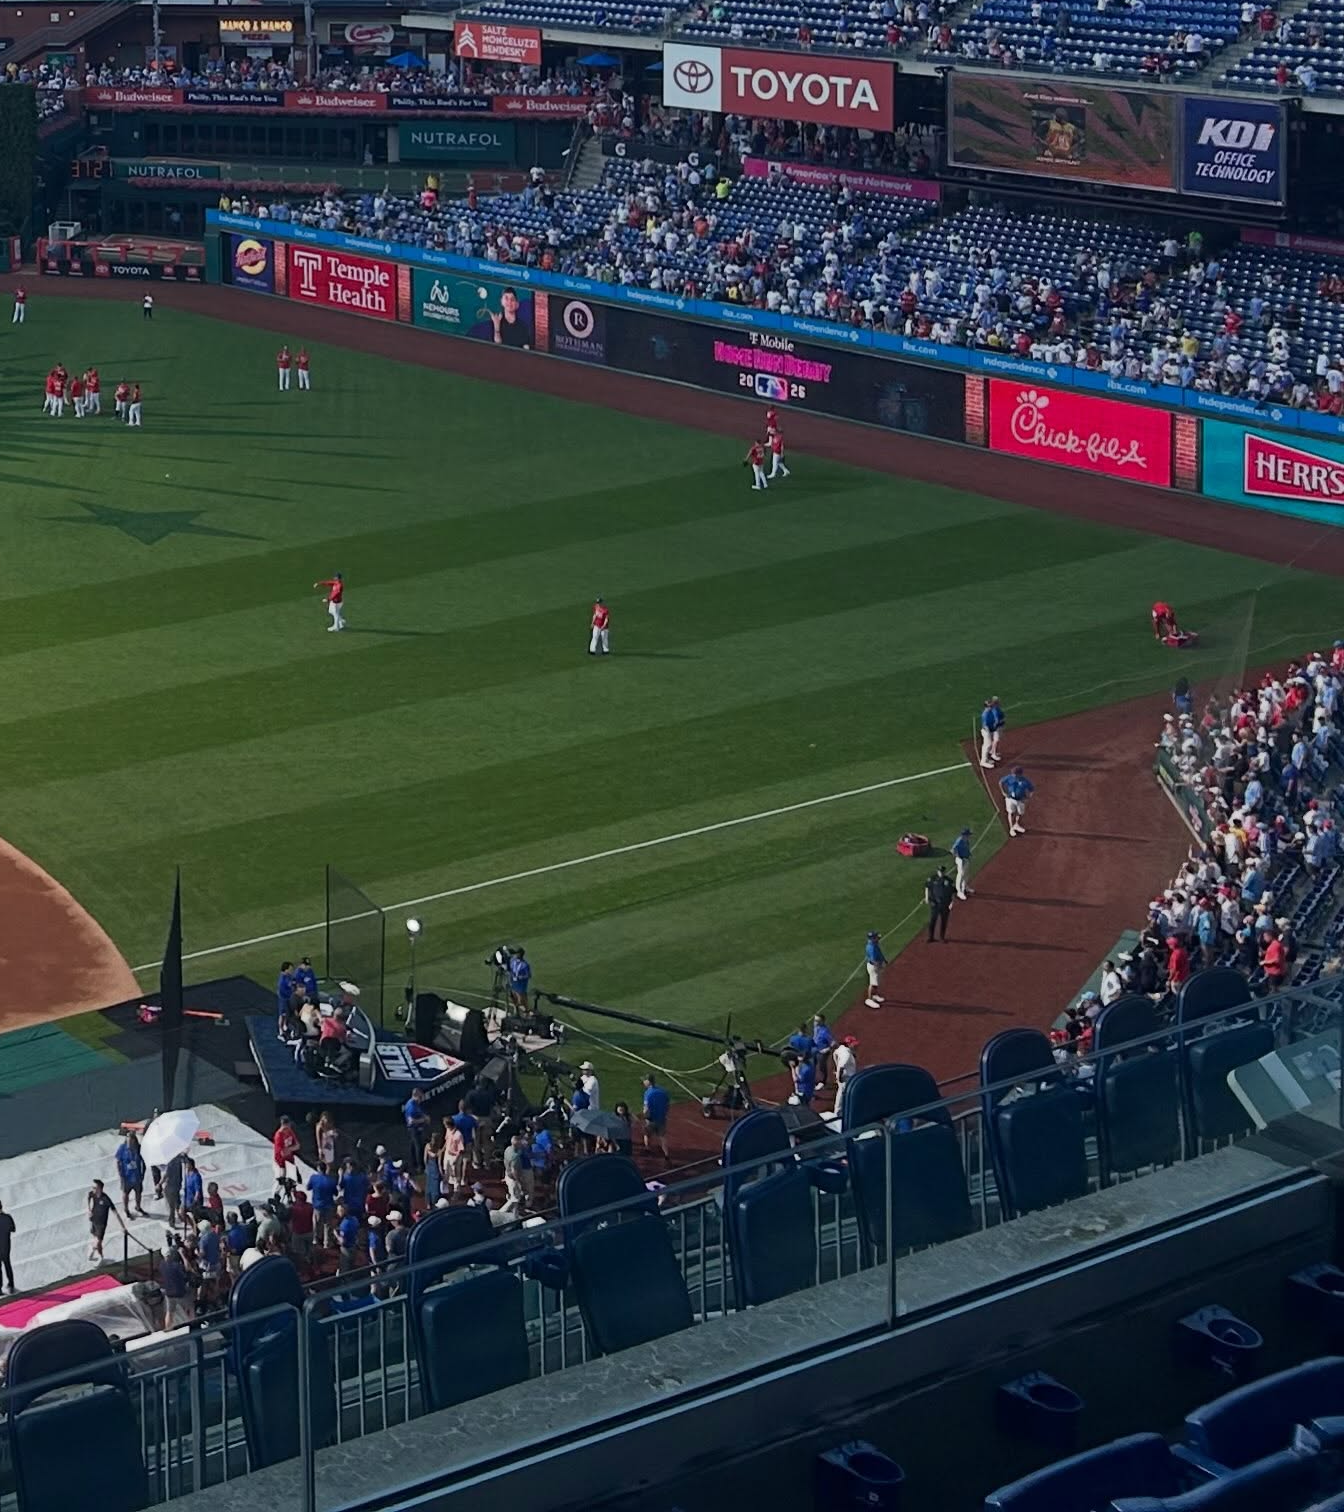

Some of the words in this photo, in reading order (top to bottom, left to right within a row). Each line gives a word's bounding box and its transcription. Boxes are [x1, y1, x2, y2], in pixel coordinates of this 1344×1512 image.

[219, 20, 251, 32] MANCO
[261, 20, 293, 32] MANCO
[482, 25, 507, 36] SALTZ
[241, 33, 270, 42] PIZZA
[482, 35, 538, 49] MONGELUZZI
[482, 45, 526, 59] BENDESKY
[115, 91, 174, 103] Budweiser
[211, 92, 228, 102] This
[730, 66, 880, 112] TOYOTA
[315, 95, 377, 108] Budweiser
[412, 132, 502, 146] NUTRAFOL
[1198, 117, 1276, 152] KDI
[615, 142, 626, 156] G
[1214, 151, 1257, 168] OFFICE
[128, 166, 203, 179] NUTRAFOL
[786, 166, 837, 183] America's
[864, 177, 913, 192] Network
[1195, 162, 1276, 185] TECHNOLOGY
[345, 238, 384, 251] Independence
[112, 266, 150, 275] TOYOTA
[327, 256, 390, 288] Temple
[479, 261, 523, 279] Independence
[328, 281, 387, 312] Health
[627, 290, 675, 307] Independence
[423, 302, 460, 316] NEMOURS
[723, 308, 754, 321] ibx.com
[793, 320, 849, 338] Independence
[555, 334, 604, 352] ROTHMAN
[760, 334, 795, 352] Mobile
[903, 342, 938, 356] ibx.com
[983, 356, 1047, 377] Independence
[739, 373, 753, 388] 20
[790, 384, 806, 398] 26
[1107, 379, 1147, 396] ibx.com
[1199, 396, 1270, 418] Independence
[1011, 401, 1147, 469] Chick-fil-A
[1255, 451, 1344, 495] HERR'S
[377, 1044, 415, 1079] MLB
